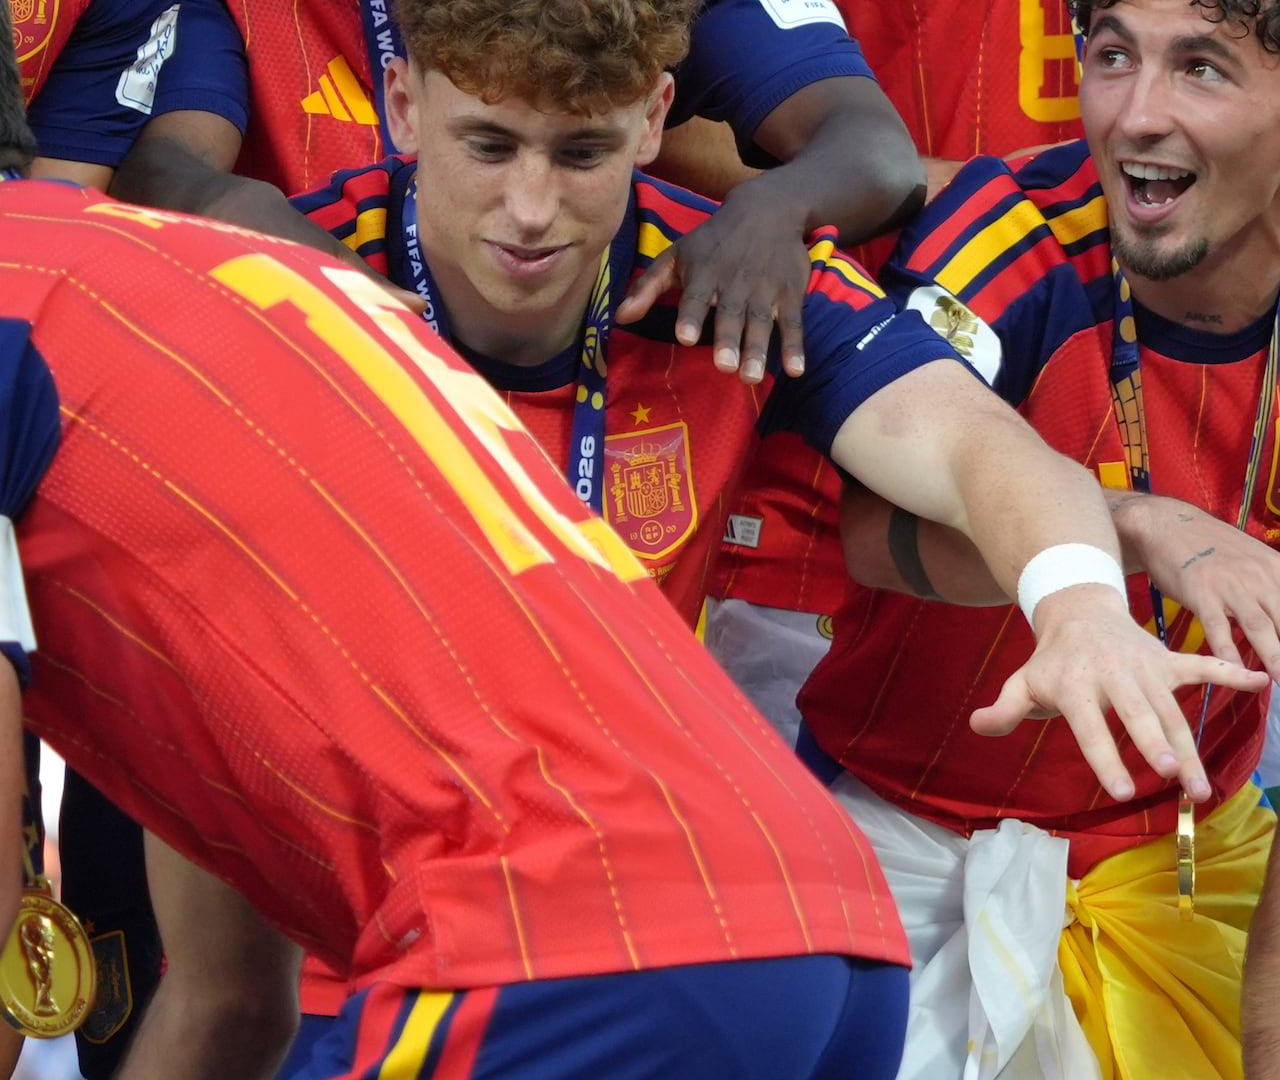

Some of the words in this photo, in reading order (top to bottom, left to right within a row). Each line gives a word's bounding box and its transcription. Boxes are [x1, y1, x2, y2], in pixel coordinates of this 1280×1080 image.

[376, 29, 396, 69] WO
[406, 224, 423, 278] FIFA
[576, 436, 596, 508] 026
